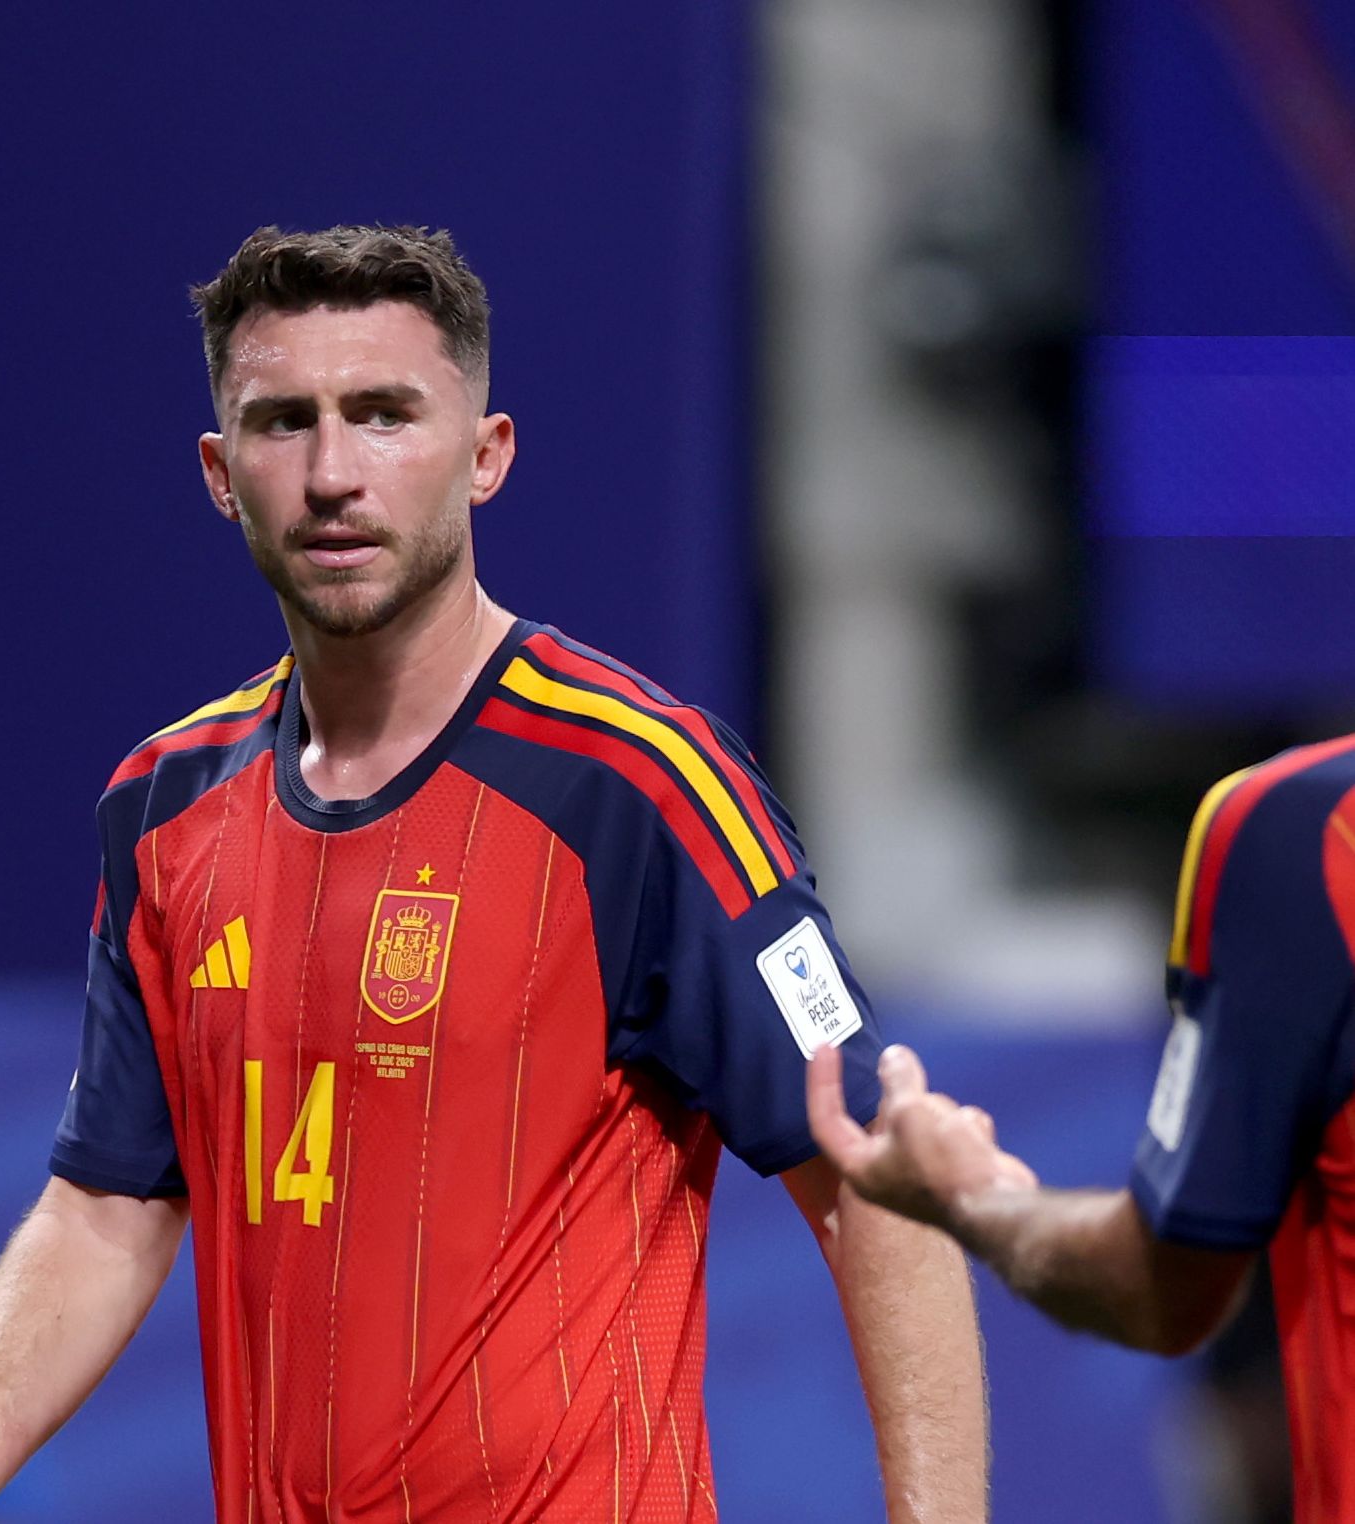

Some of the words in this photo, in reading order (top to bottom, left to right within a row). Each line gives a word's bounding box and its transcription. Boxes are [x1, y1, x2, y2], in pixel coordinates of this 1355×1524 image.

[808, 993, 839, 1026] PEACE
[824, 1018, 841, 1035] FIFA
[370, 1055, 377, 1065] 15
[379, 1056, 394, 1065] JUNE
[396, 1057, 414, 1067] 2026
[377, 1068, 405, 1078] ATLANTA
[245, 1060, 335, 1227] 14
